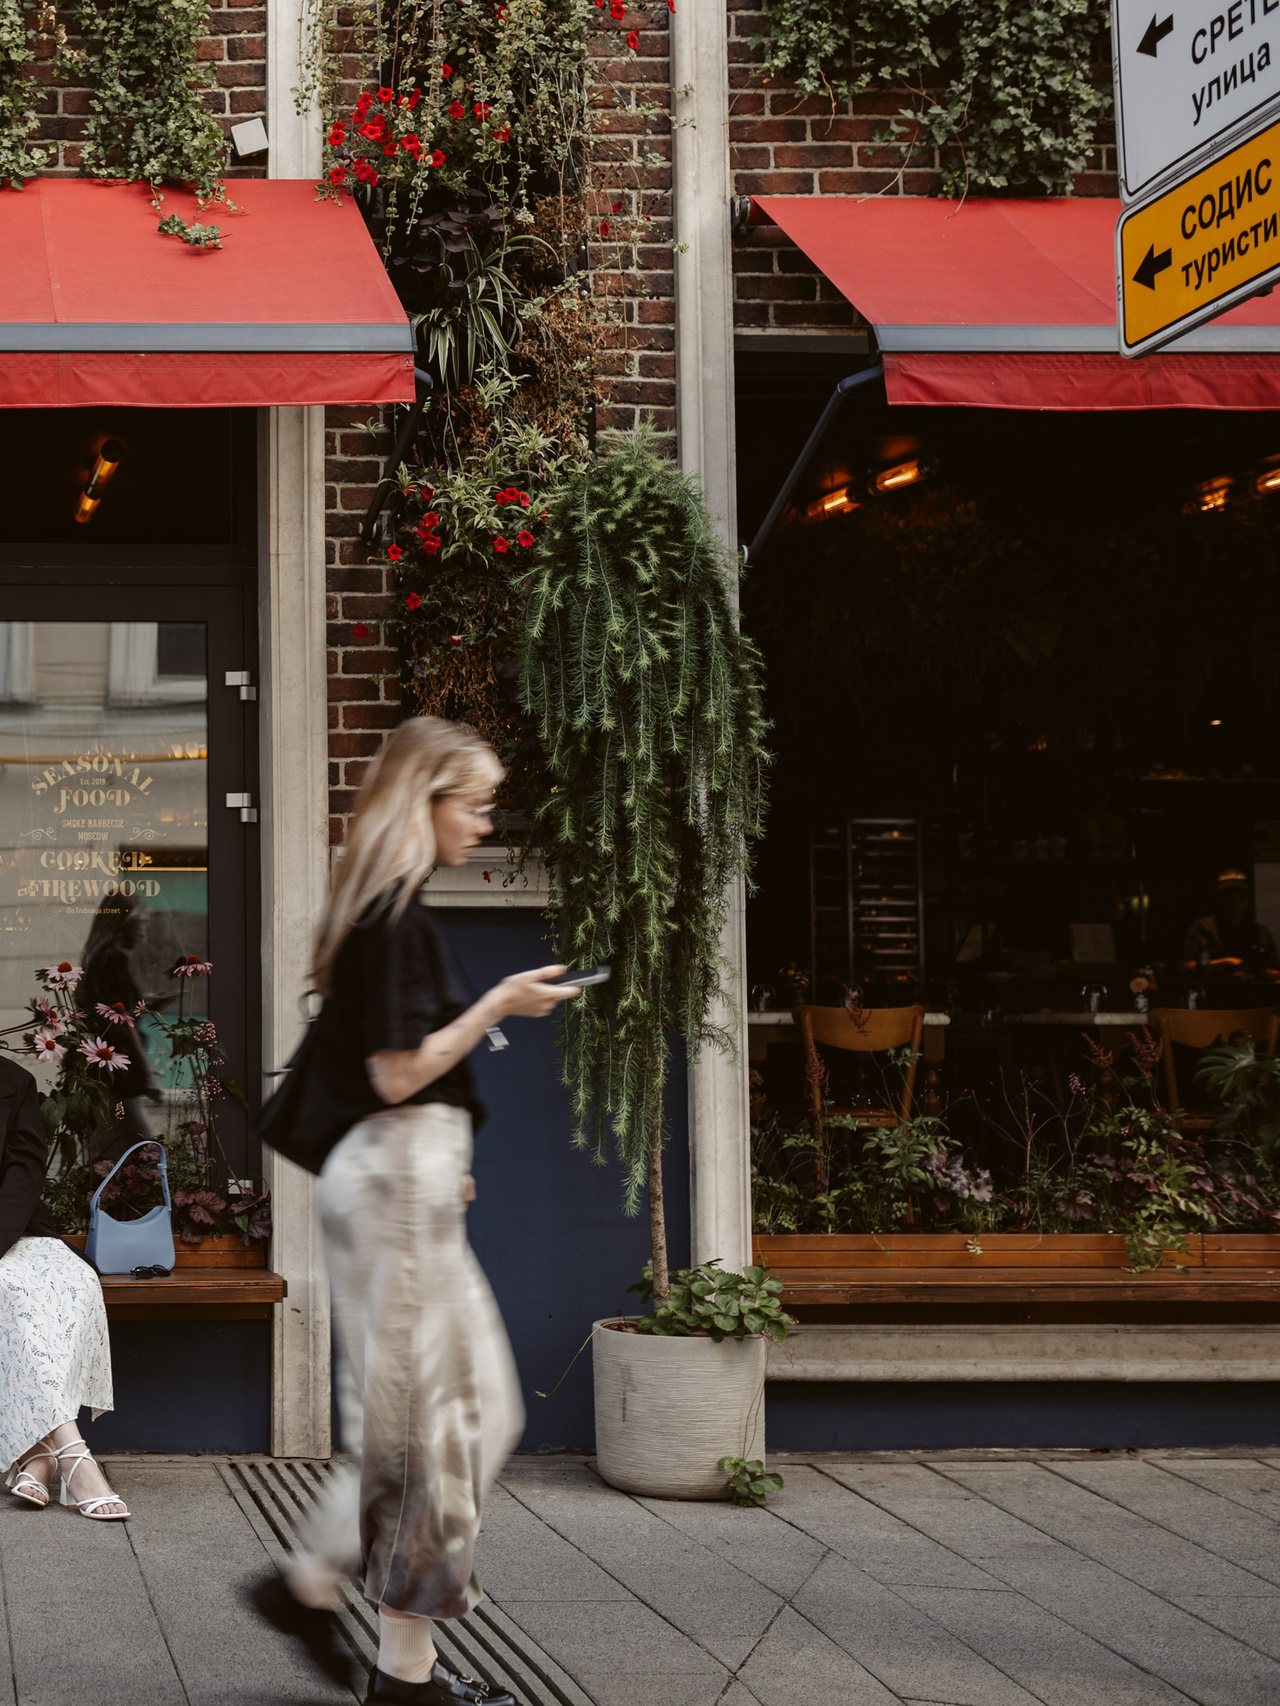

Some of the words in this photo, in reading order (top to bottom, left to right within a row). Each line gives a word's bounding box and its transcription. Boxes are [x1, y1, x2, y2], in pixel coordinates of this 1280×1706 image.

[1192, 42, 1271, 126] улица
[1181, 158, 1272, 240] СОДИС
[1181, 210, 1280, 291] туристи
[31, 755, 154, 796] SEASONAL
[92, 778, 106, 786] 2019
[53, 788, 131, 814] FOOD
[61, 819, 86, 828] SMOKE
[88, 819, 125, 828] BARBECUE
[78, 832, 108, 841] MOSCOW
[40, 851, 147, 877] COOKED
[29, 879, 161, 904] FIREWOOD
